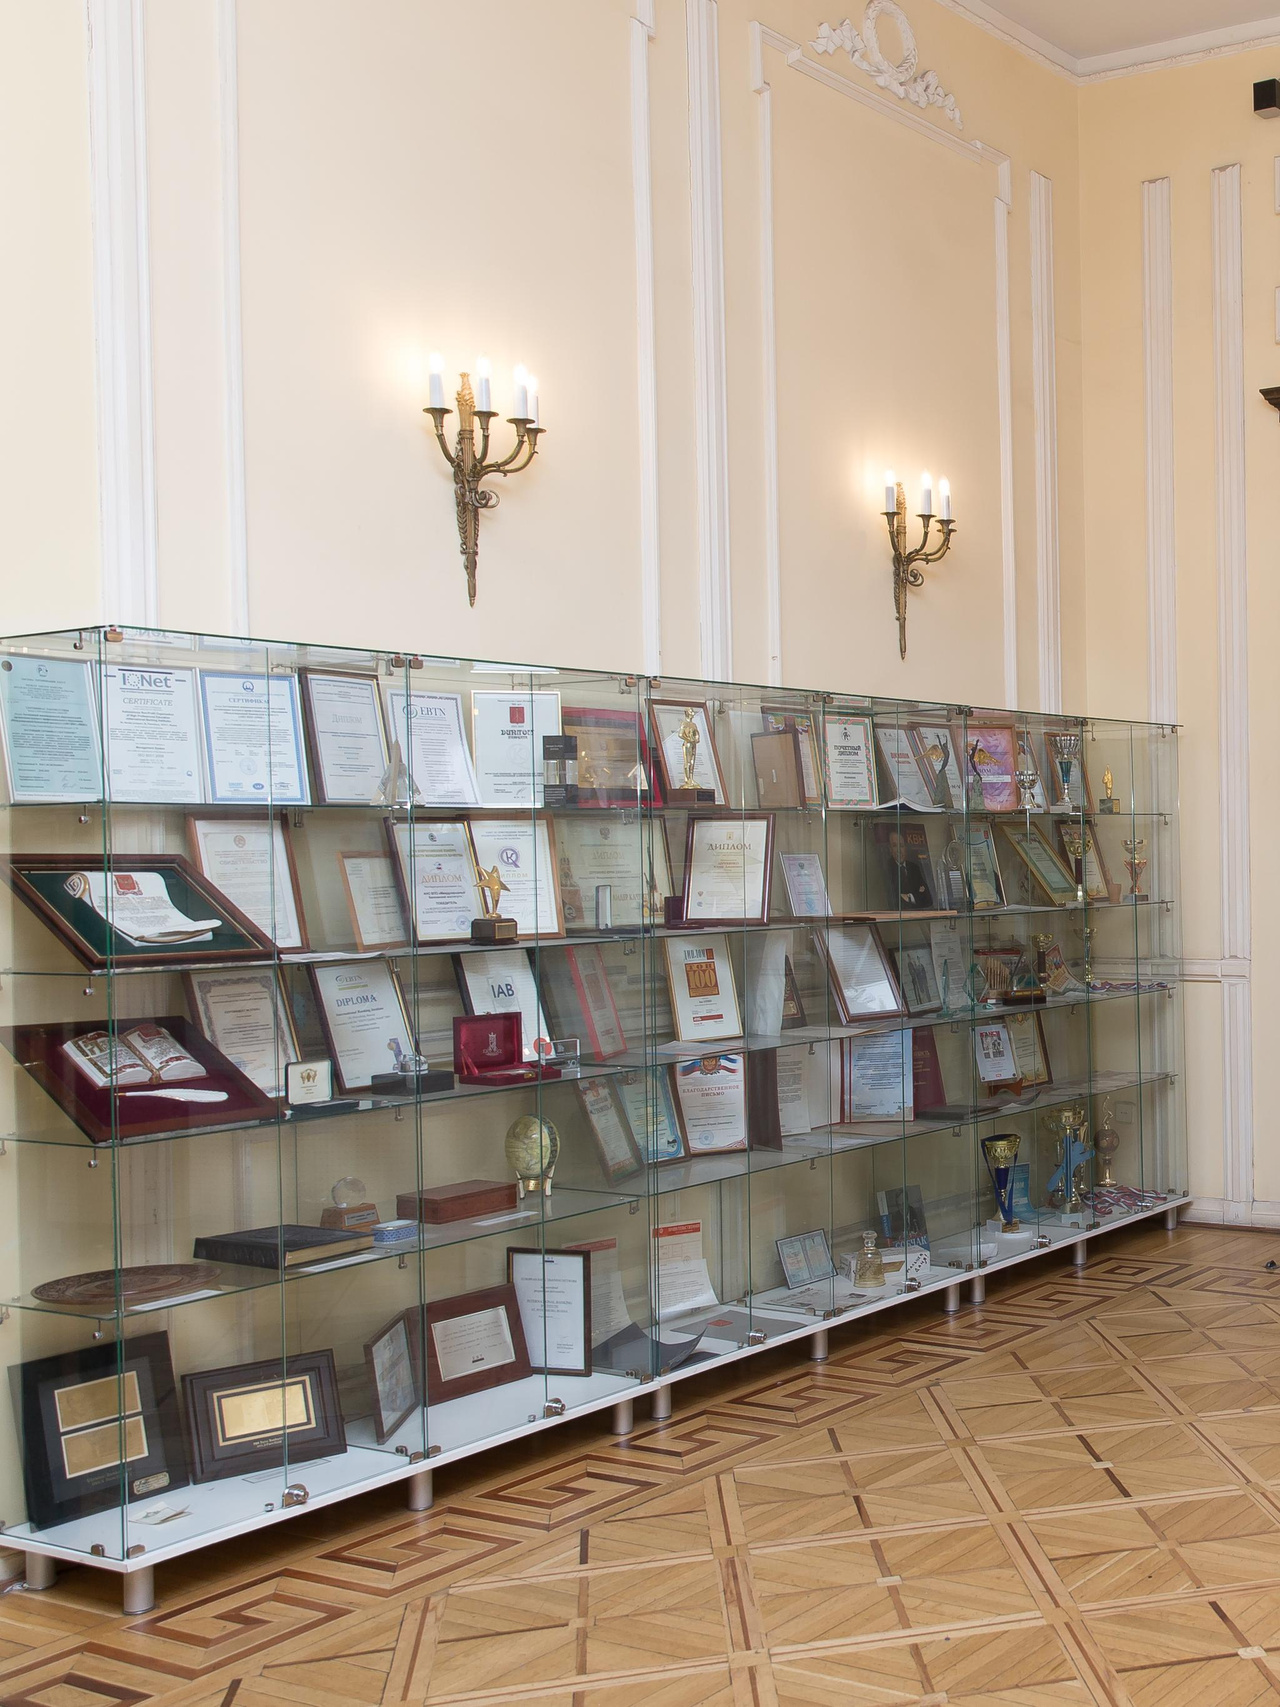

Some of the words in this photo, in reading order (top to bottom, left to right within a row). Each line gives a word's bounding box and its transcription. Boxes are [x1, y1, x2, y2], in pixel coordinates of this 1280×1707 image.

[122, 697, 173, 706] CERTIFICATE
[420, 706, 446, 716] EBTN
[906, 833, 925, 845] КВН
[706, 843, 752, 851] ДИПЛОМ
[421, 874, 463, 884] ДИПЛОМ
[688, 969, 716, 989] 100
[491, 983, 515, 998] IAB
[336, 994, 378, 1007] DIPLOMA
[683, 1084, 740, 1094] БЛАГОДАРСТВЕННОЕ
